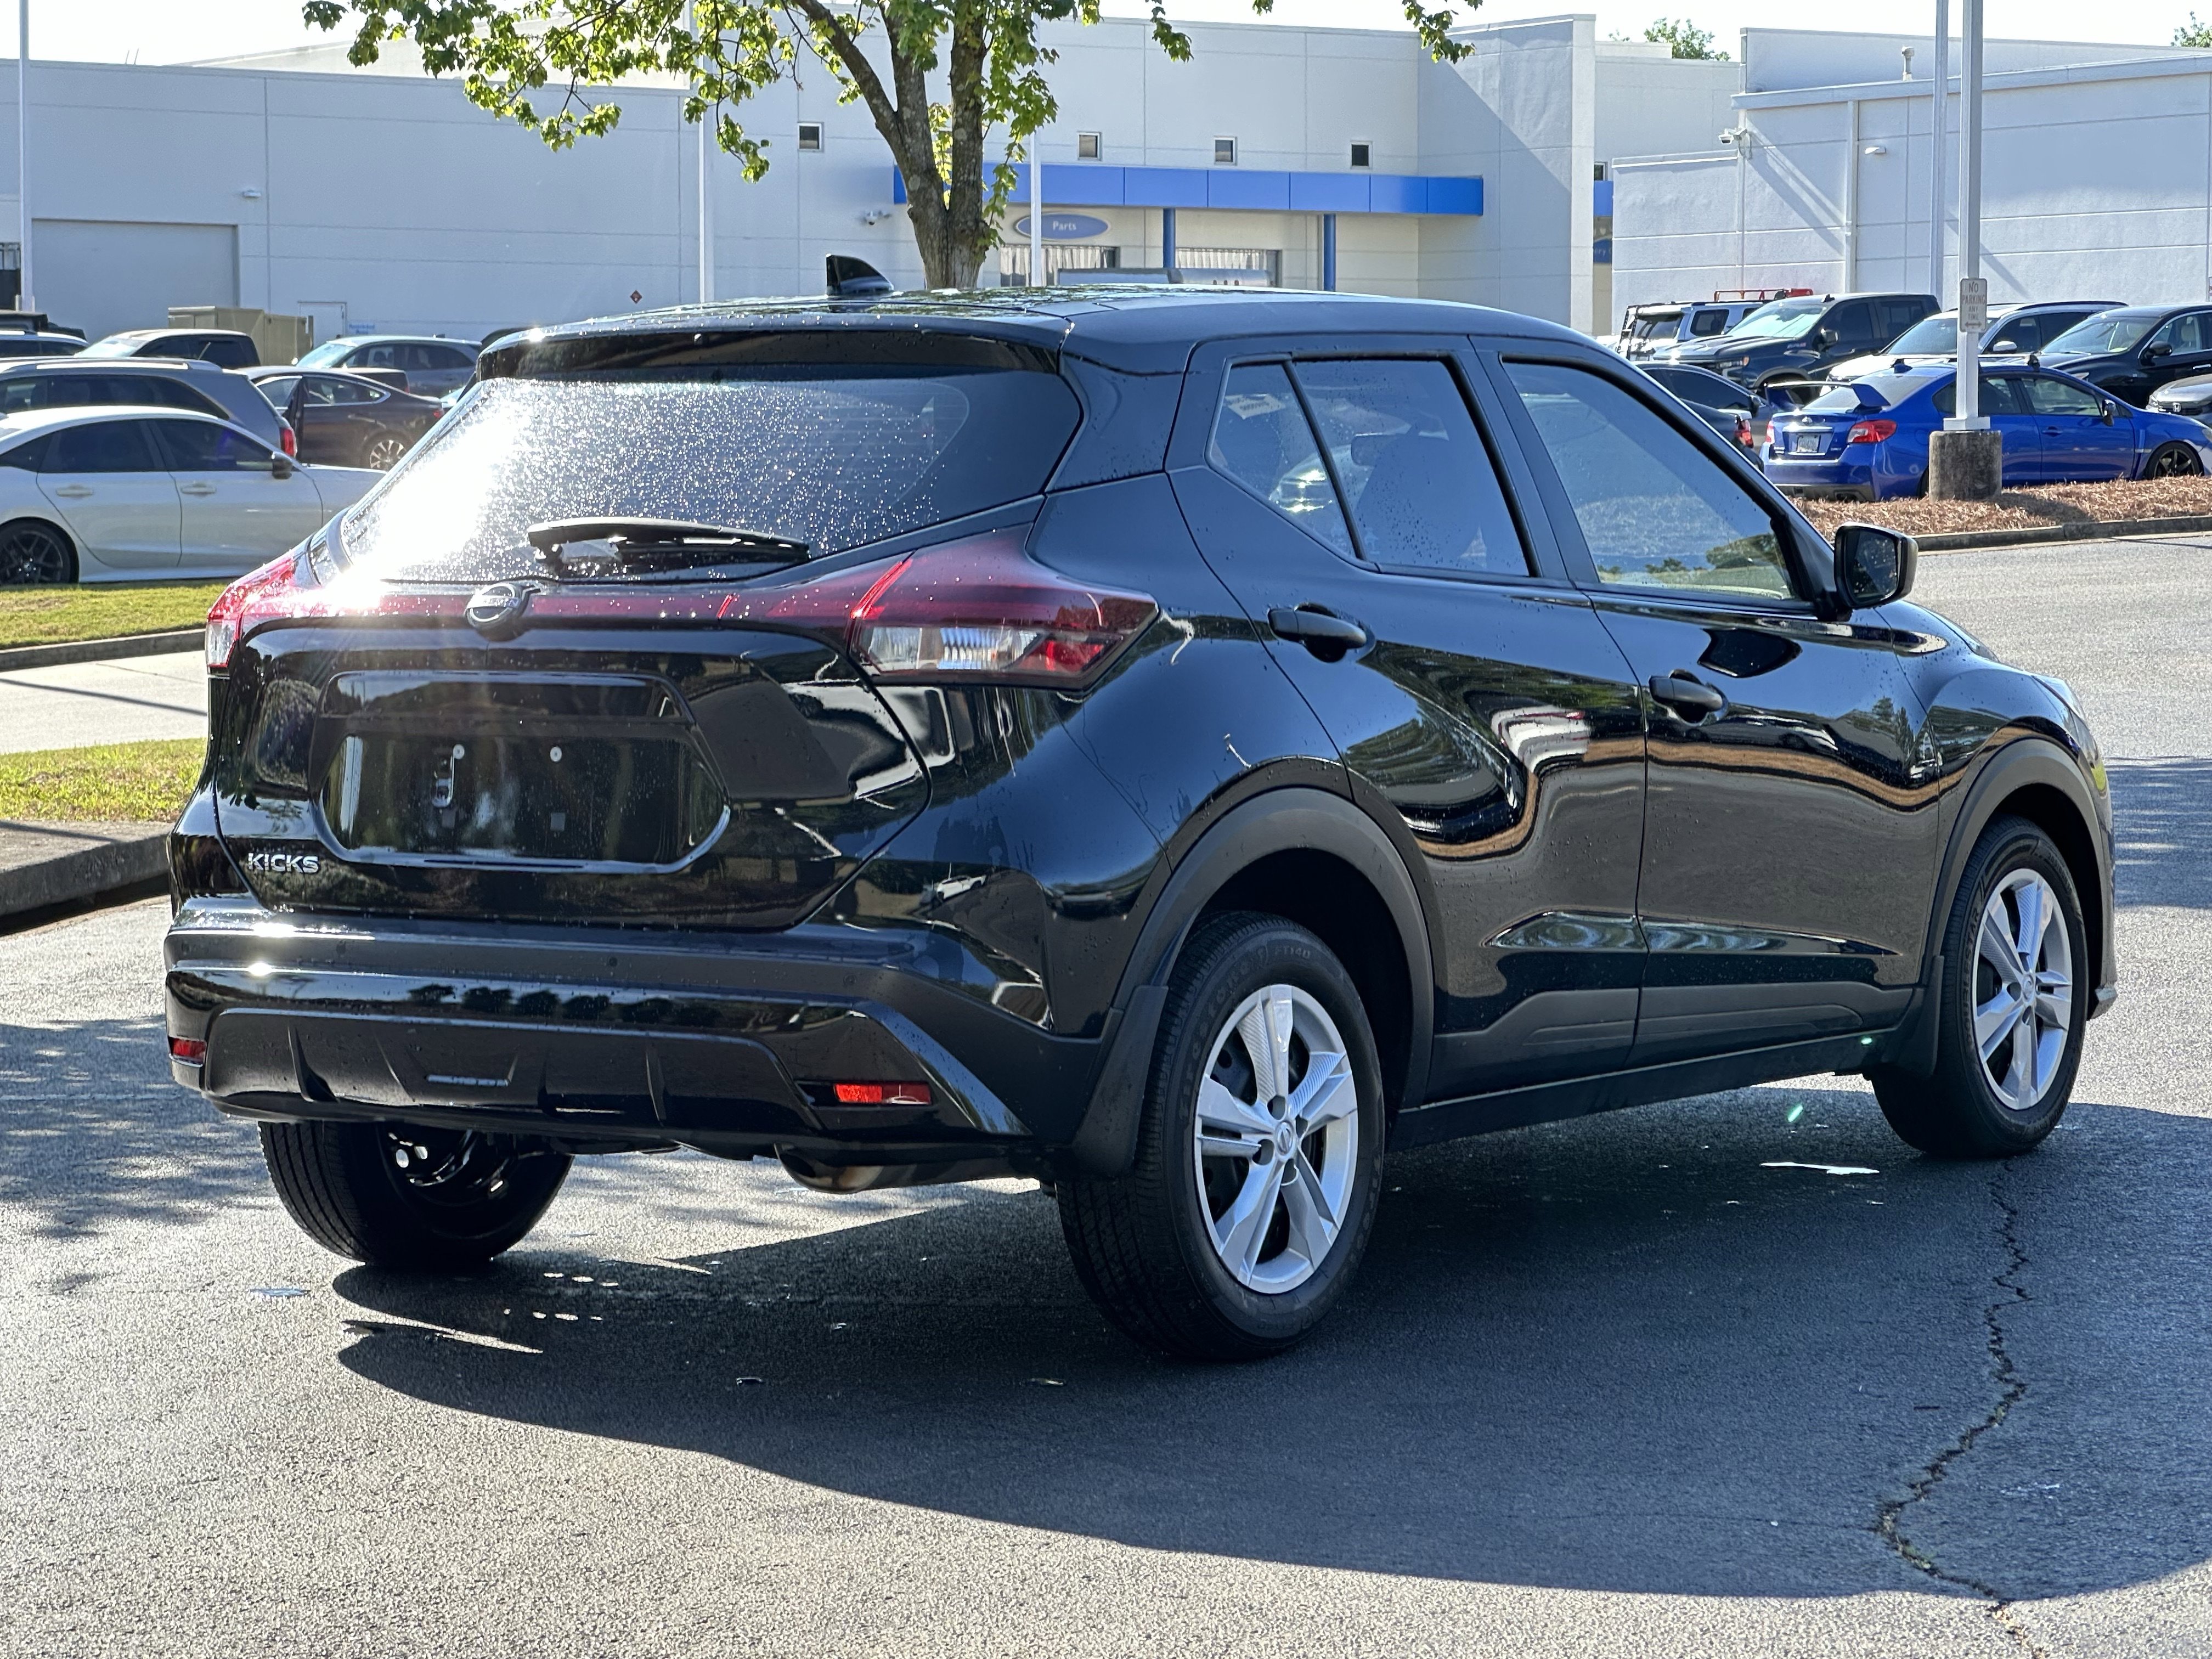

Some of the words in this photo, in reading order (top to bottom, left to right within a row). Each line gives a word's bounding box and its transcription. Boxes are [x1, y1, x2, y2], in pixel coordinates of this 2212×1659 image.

[1053, 221, 1076, 231] Parts
[1968, 283, 1979, 292] NO
[1961, 295, 1986, 304] PARKING
[248, 853, 319, 873] KICKS
